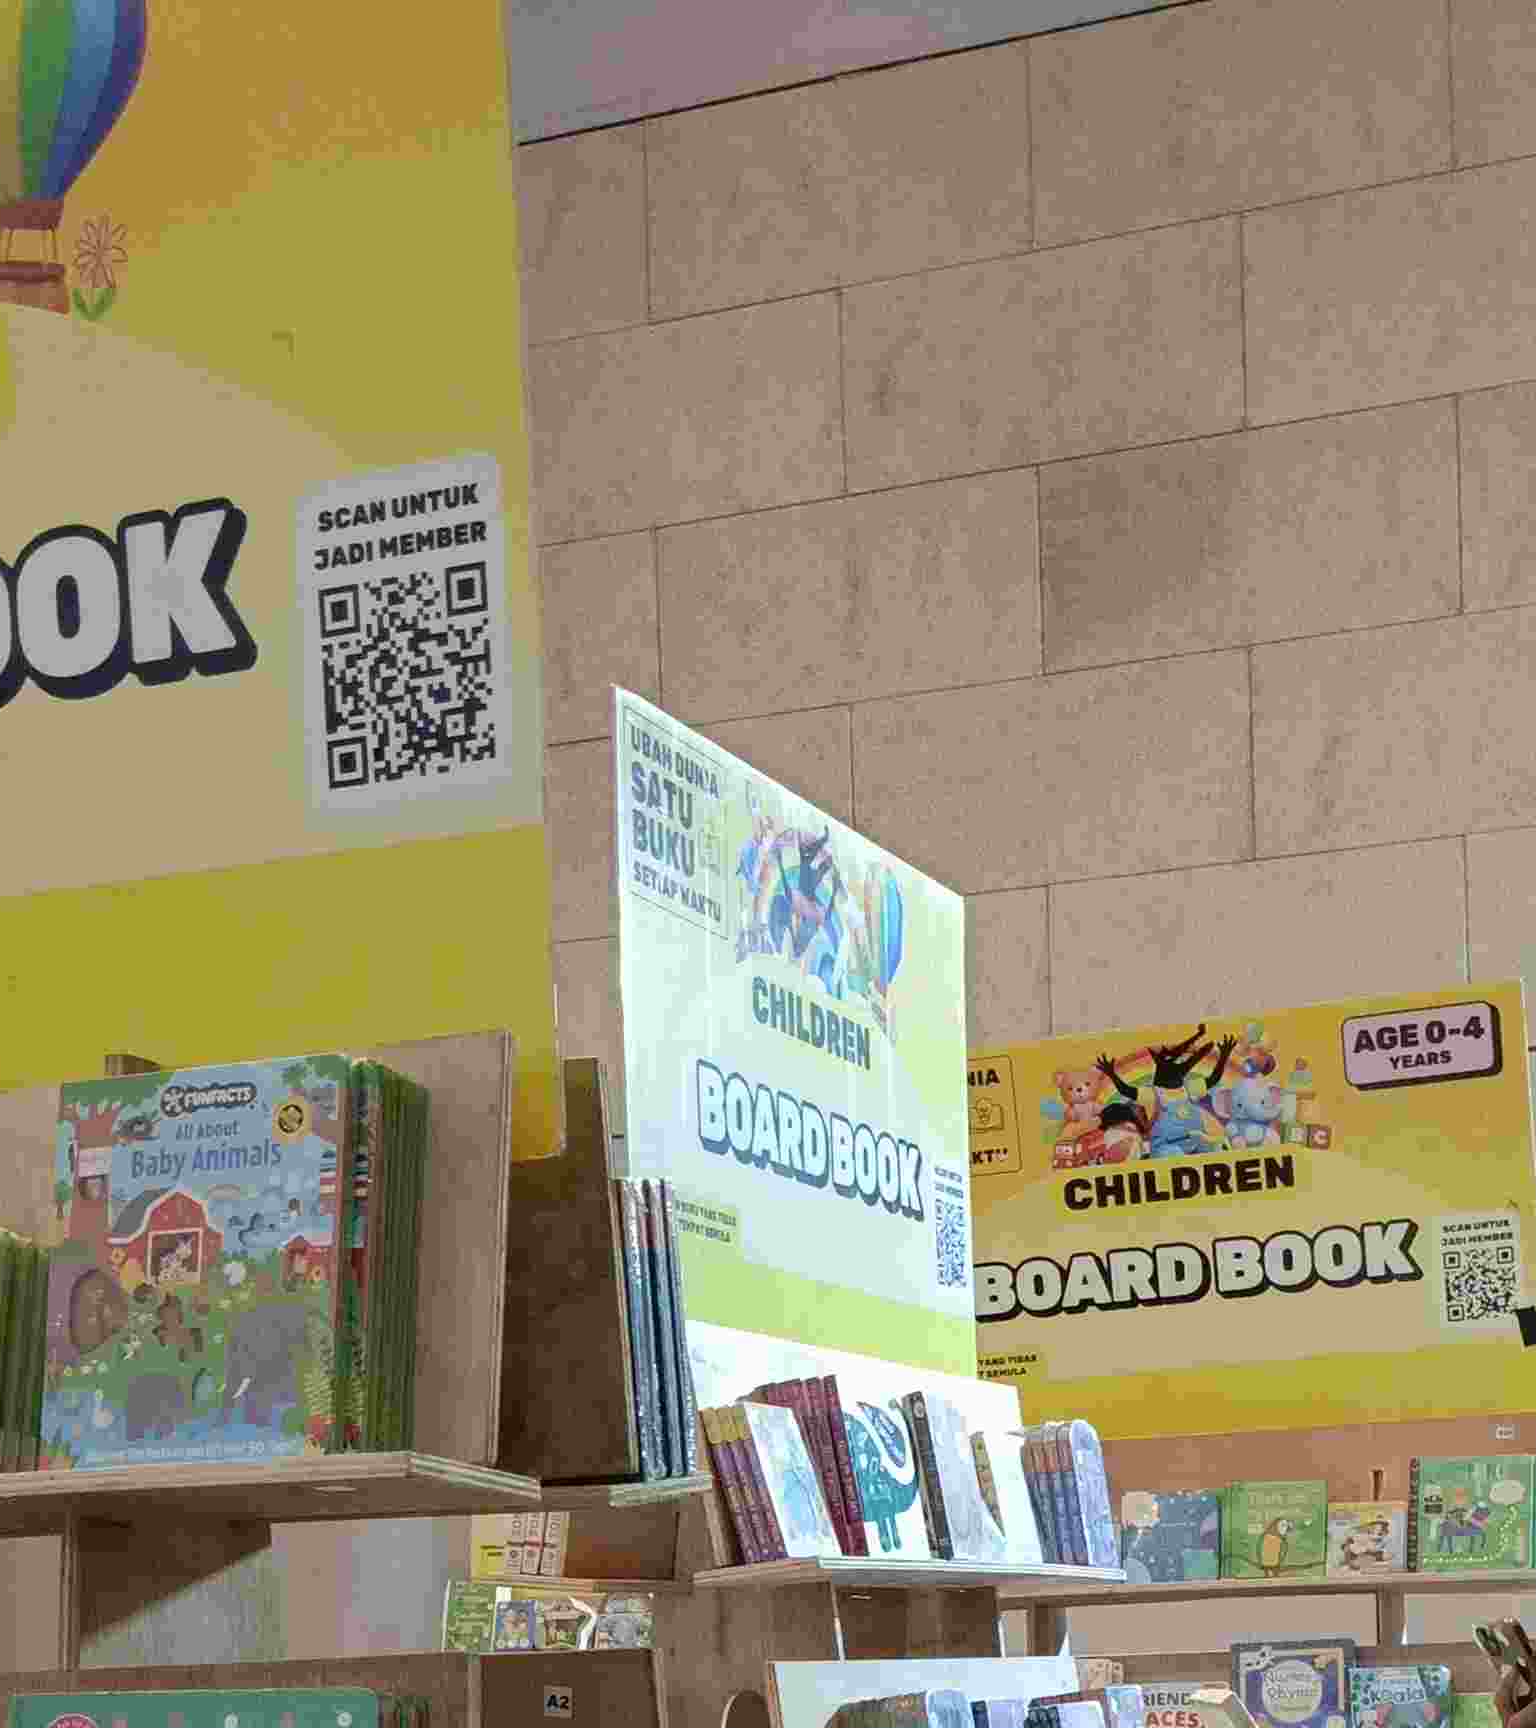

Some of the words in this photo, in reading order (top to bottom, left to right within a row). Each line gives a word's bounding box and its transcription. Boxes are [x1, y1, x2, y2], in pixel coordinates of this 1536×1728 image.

[316, 500, 388, 534] SCAN
[391, 481, 481, 519] UNTUK
[313, 537, 375, 571] JADI
[379, 520, 488, 560] MEMBER
[630, 724, 673, 771] UBAH
[631, 761, 694, 830] SATU
[631, 808, 696, 878] BUKU
[751, 974, 873, 1071] CHILDREN
[1354, 1022, 1420, 1055] AGE
[1424, 1015, 1486, 1045] 0-4
[1388, 1047, 1452, 1072] YEARS
[175, 1121, 193, 1141] All
[196, 1119, 240, 1140] About
[696, 1057, 831, 1188] BOARD
[830, 1111, 926, 1221] BOOK
[130, 1148, 187, 1181] Baby
[192, 1138, 282, 1173] Animals
[1064, 1154, 1296, 1212] CHILDREN
[1441, 1237, 1466, 1248] JADI
[1442, 1223, 1472, 1234] SCAN
[1473, 1218, 1511, 1231] UNTUK
[974, 1242, 1210, 1322] BOARD
[1212, 1218, 1424, 1299] BOOK
[546, 1694, 570, 1711] A2
